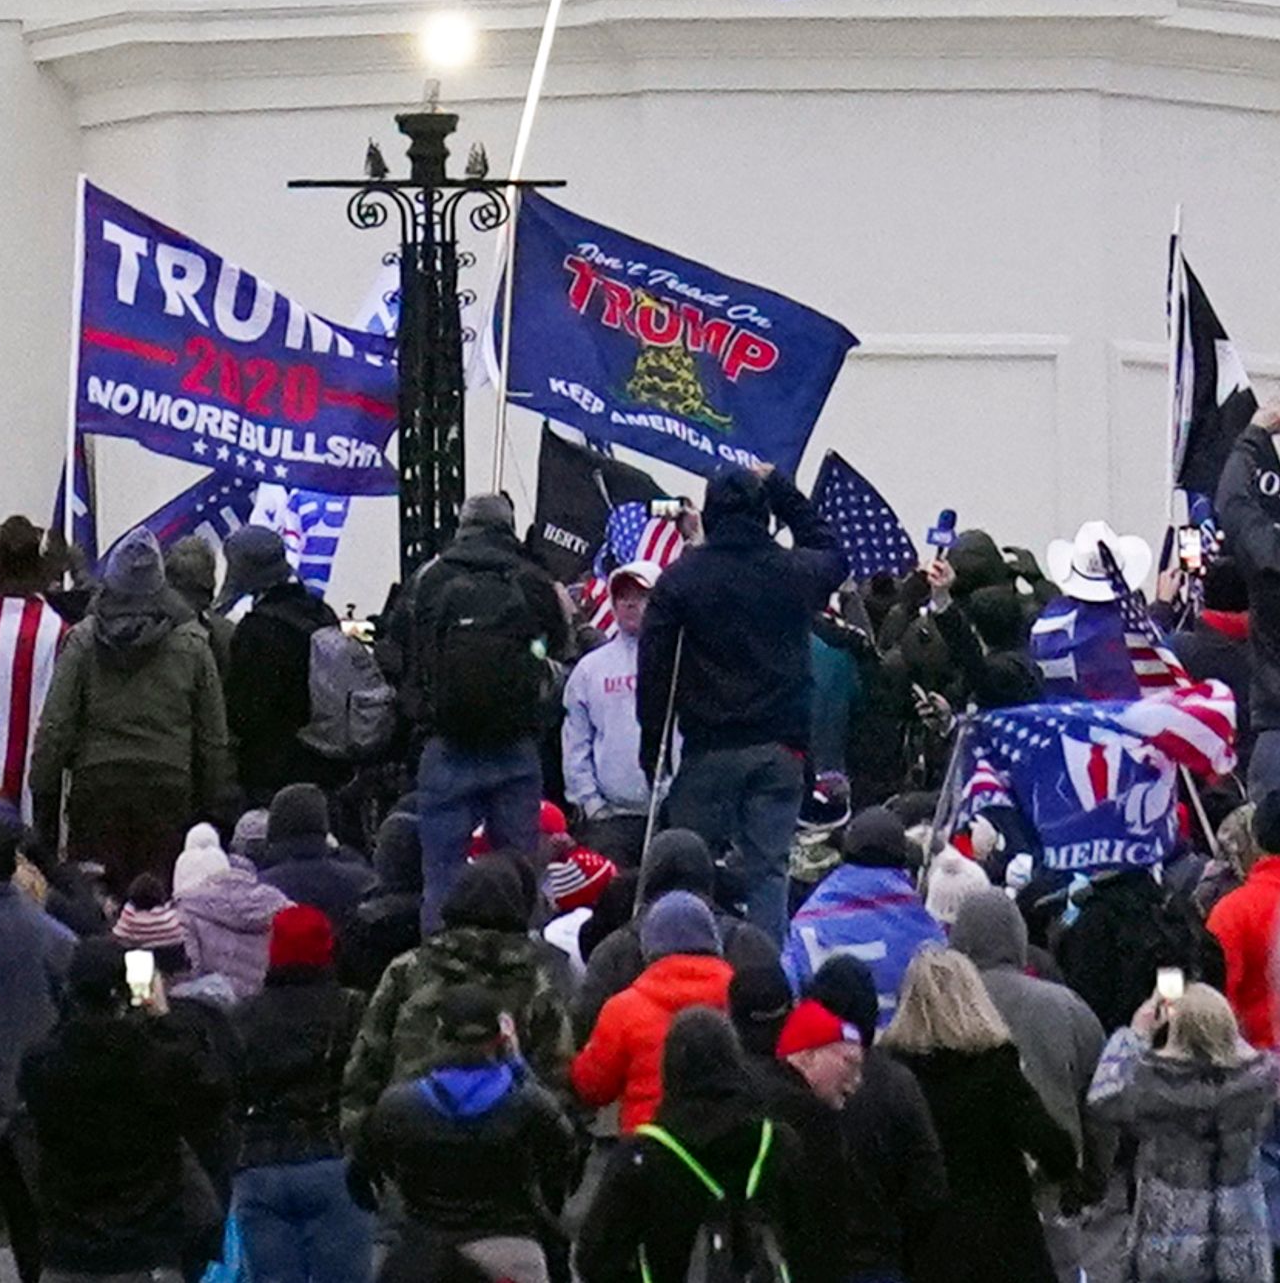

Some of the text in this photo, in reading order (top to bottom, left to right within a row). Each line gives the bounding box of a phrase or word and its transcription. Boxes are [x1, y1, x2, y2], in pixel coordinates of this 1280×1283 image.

[563, 254, 779, 383] TRUMP
[726, 304, 773, 329] On
[87, 376, 140, 416] NO
[138, 393, 241, 443] MORE
[548, 377, 605, 416] KEEP
[610, 412, 715, 457] AMERICA
